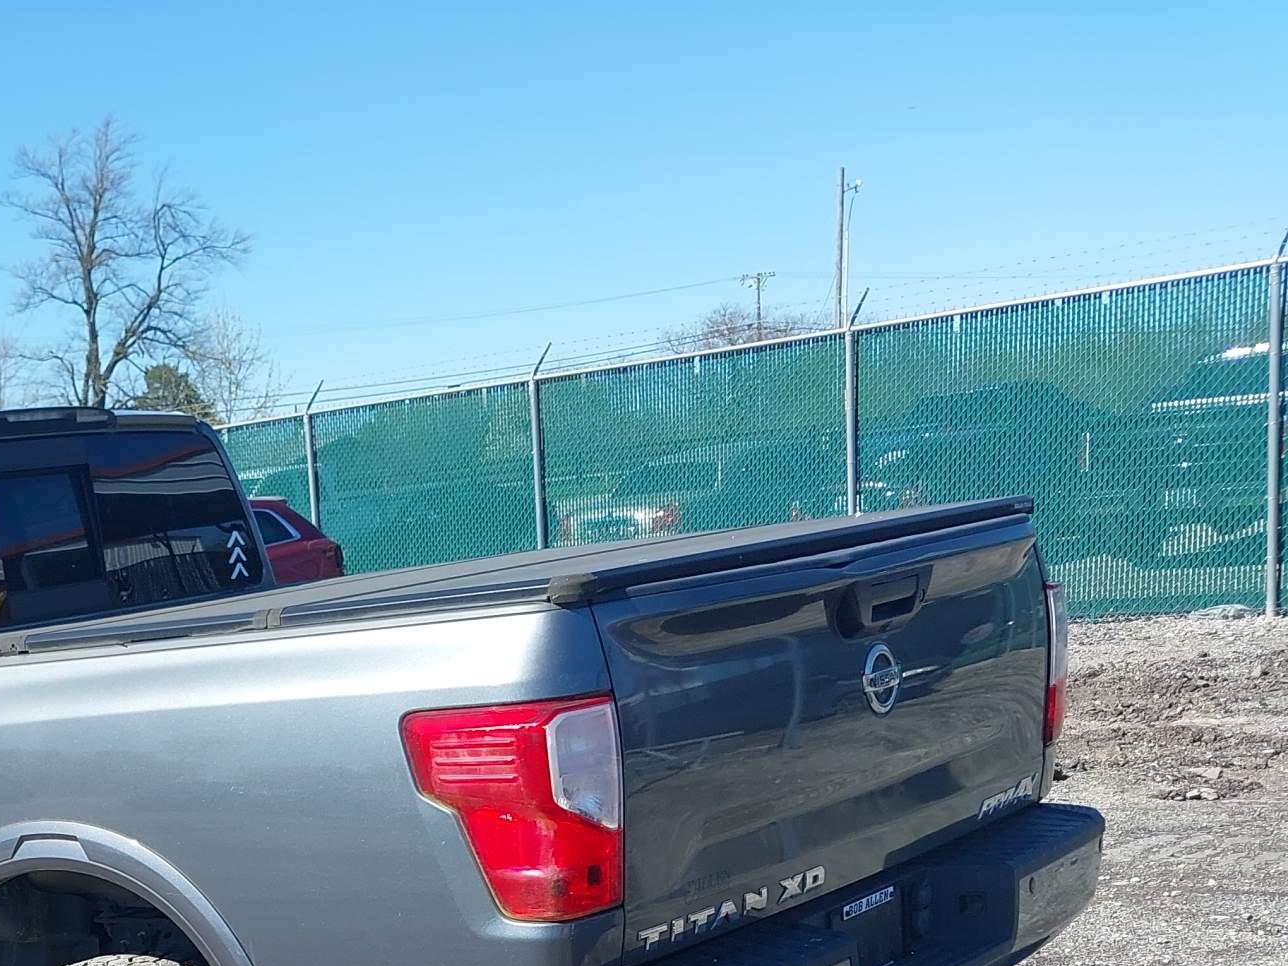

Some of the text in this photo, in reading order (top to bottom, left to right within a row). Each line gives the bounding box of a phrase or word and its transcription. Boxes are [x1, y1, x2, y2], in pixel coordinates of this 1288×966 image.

[638, 886, 768, 951] TITAN
[777, 865, 826, 905] XD
[848, 889, 890, 916] BOB ALLEN
